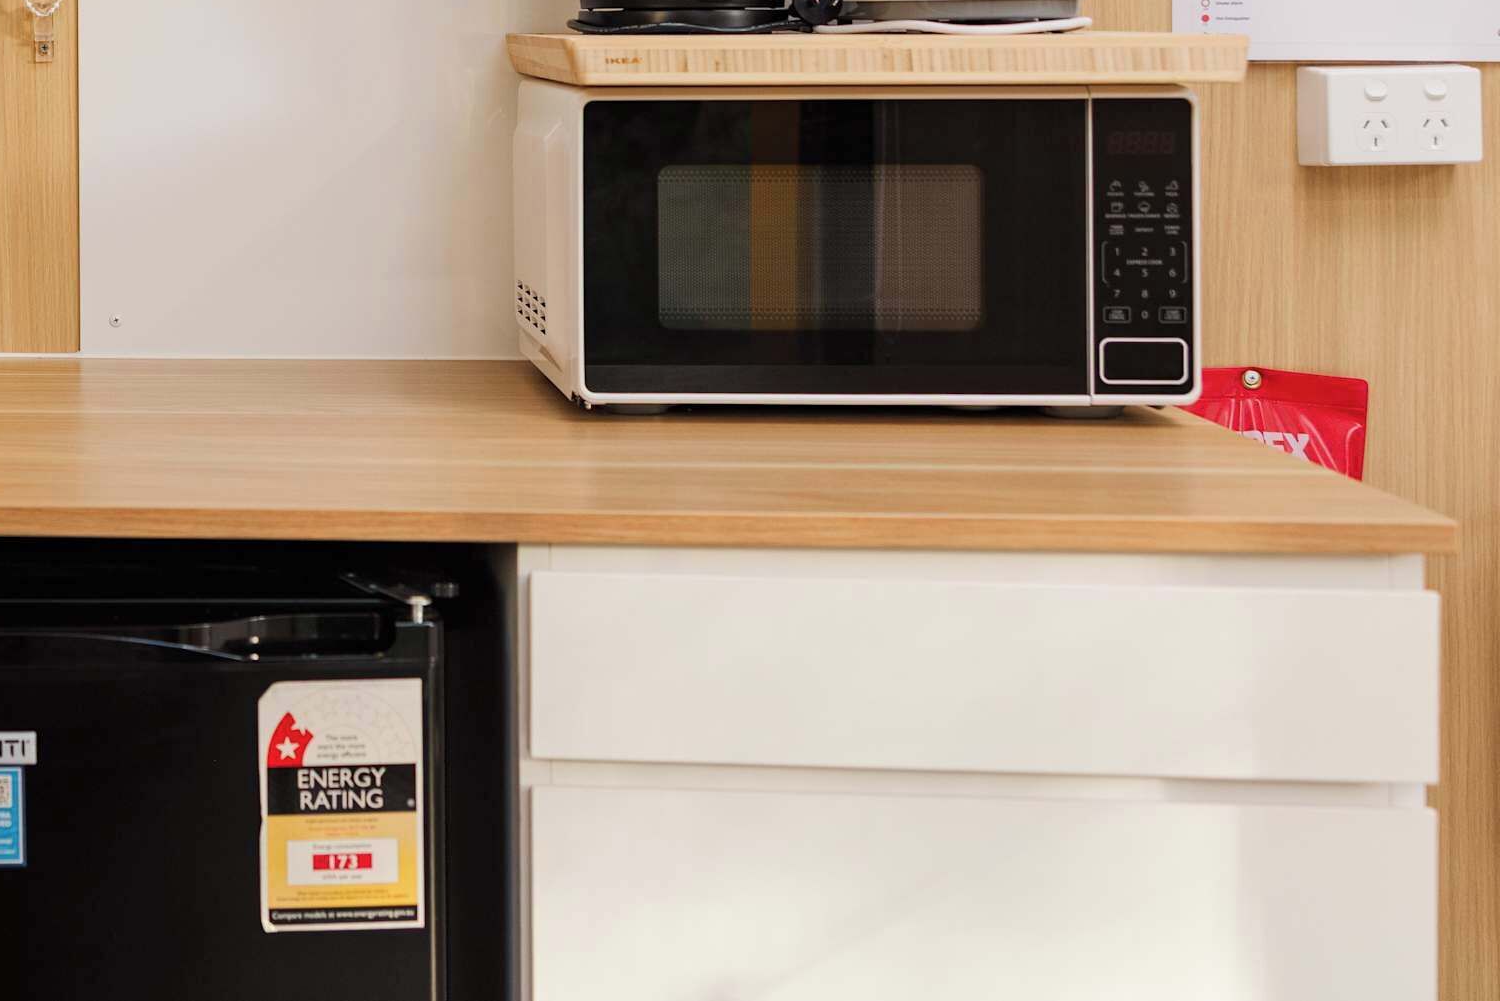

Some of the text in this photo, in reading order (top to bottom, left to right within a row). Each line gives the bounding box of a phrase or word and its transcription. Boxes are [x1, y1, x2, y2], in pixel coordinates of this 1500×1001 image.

[1141, 246, 1148, 256] 2
[1113, 268, 1177, 277] 4 5 6
[1113, 289, 1120, 298] 7
[1168, 289, 1177, 298] 9
[297, 766, 386, 789] ENERGY
[300, 788, 384, 811] RATING
[328, 854, 358, 870] 173
